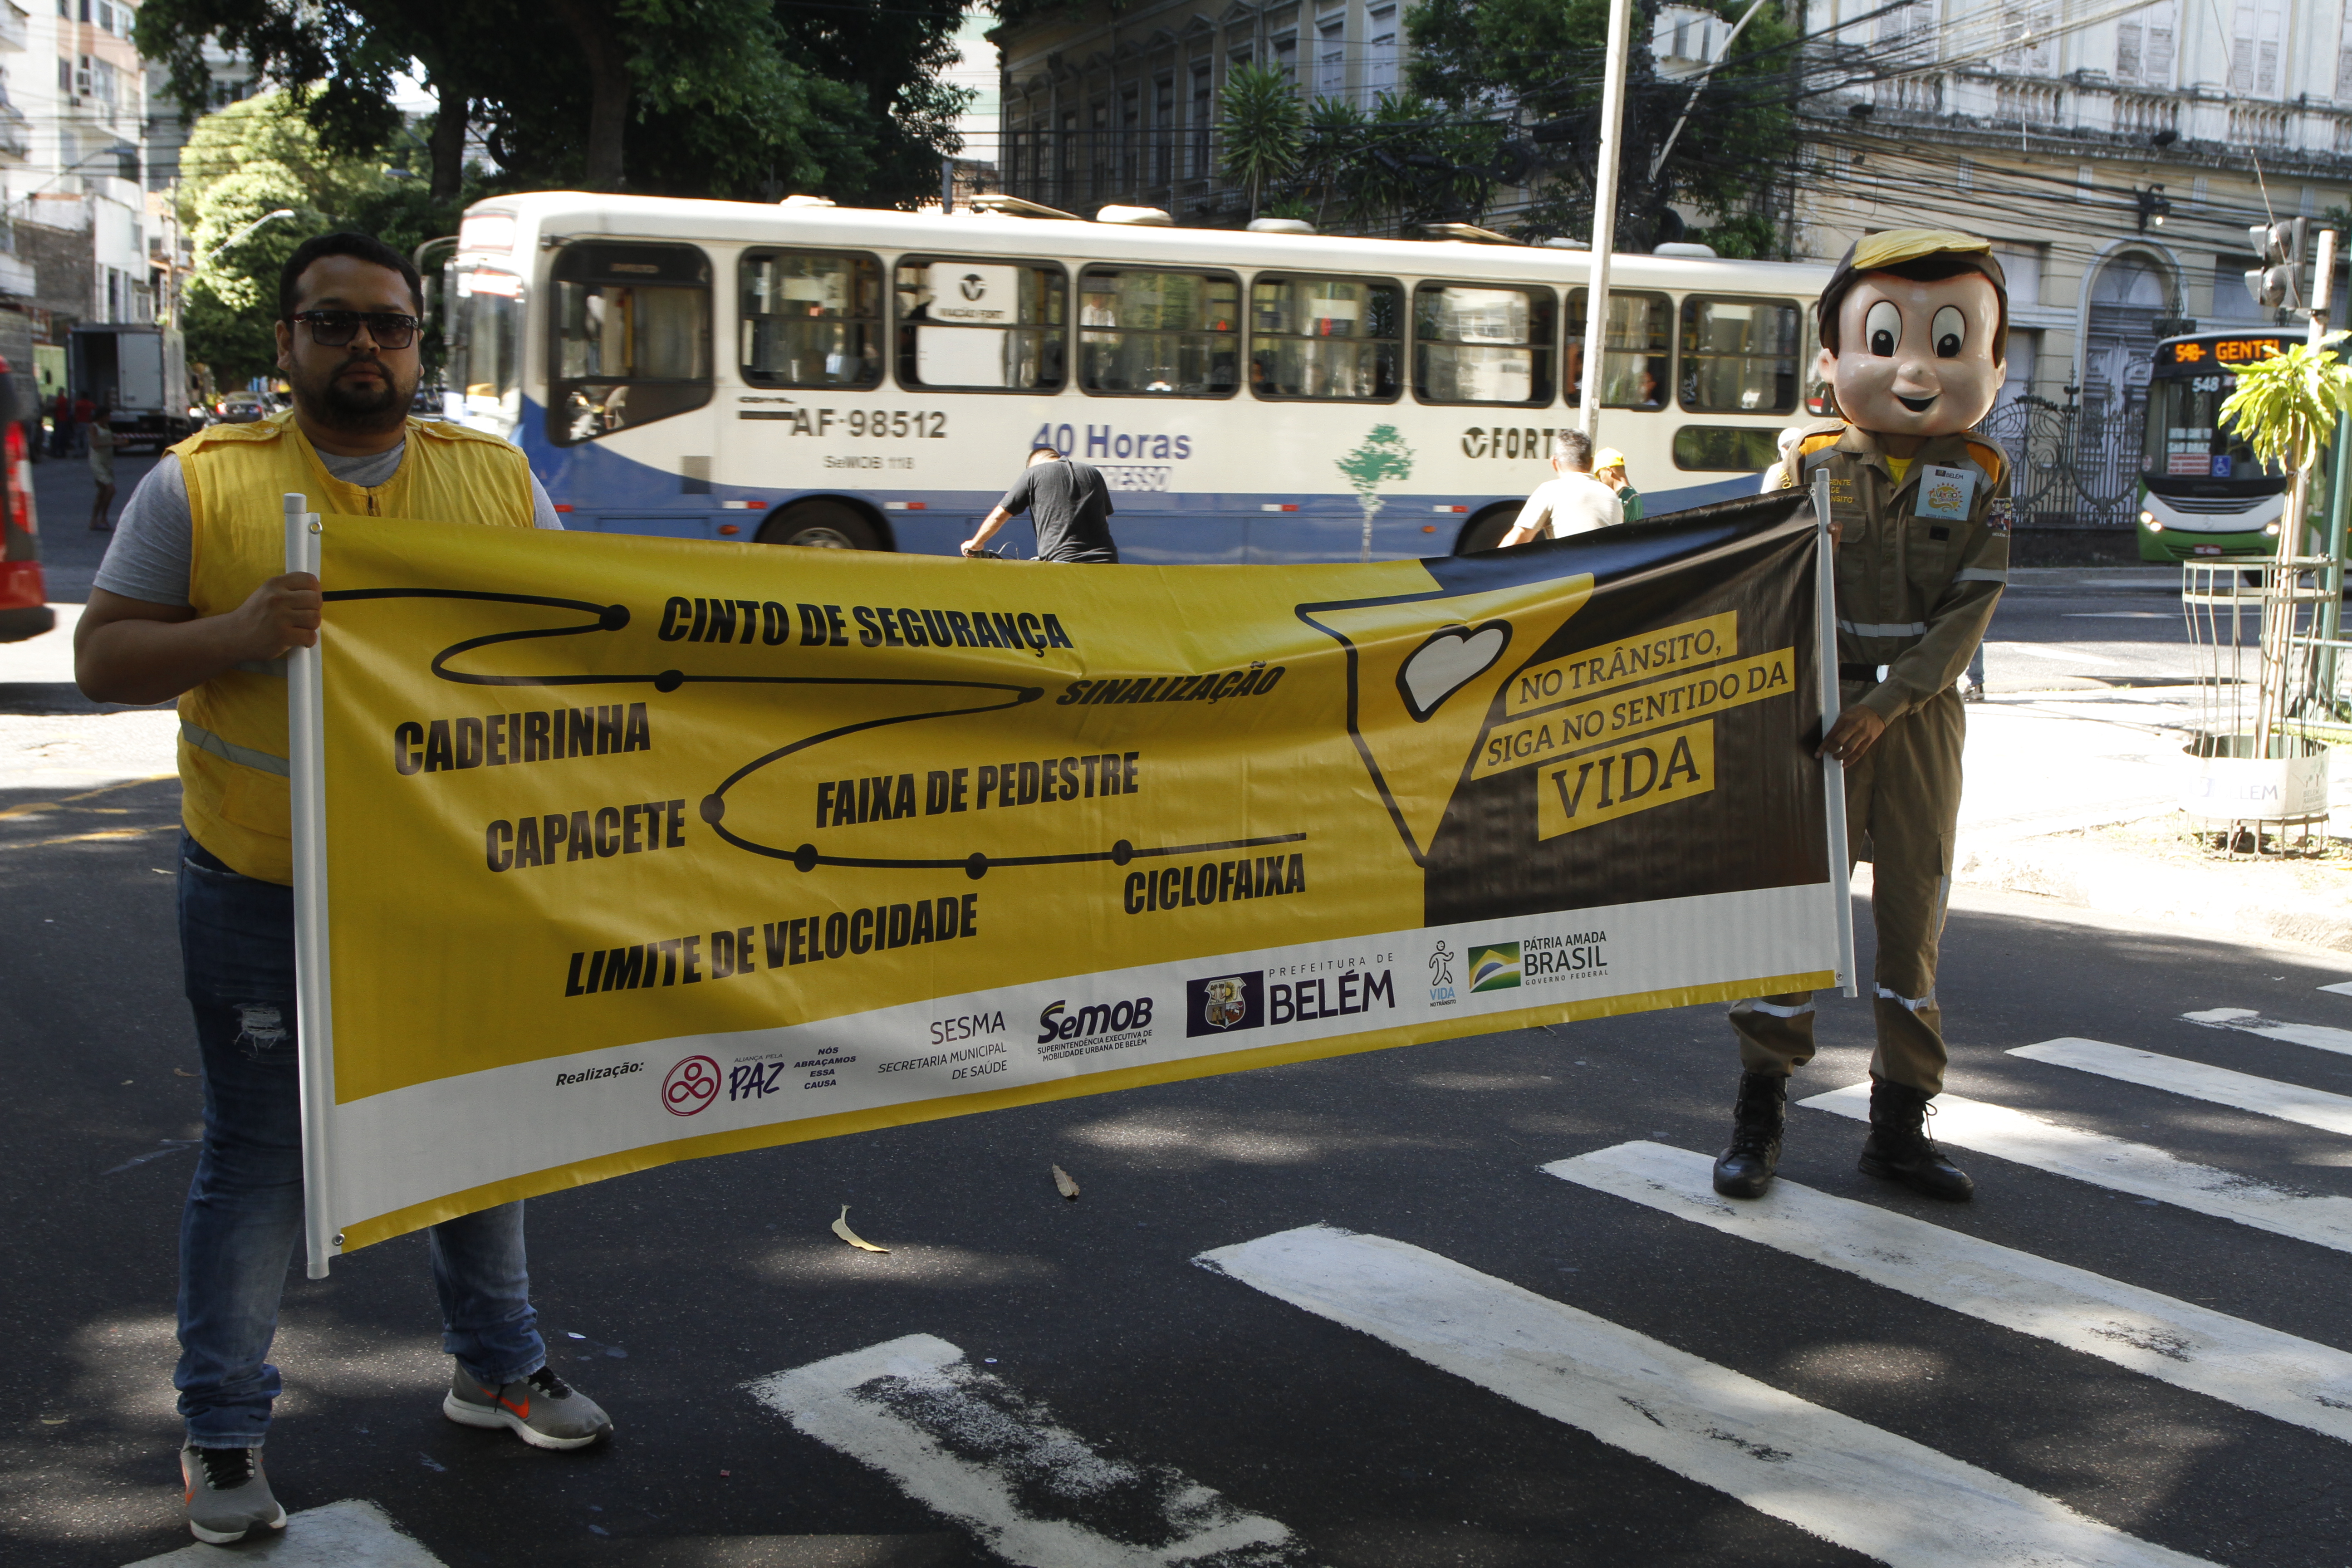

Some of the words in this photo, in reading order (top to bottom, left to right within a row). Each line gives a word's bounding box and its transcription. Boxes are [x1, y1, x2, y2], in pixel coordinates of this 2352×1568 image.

[2192, 376, 2220, 392] 548
[1032, 422, 1074, 456] 40
[1086, 424, 1192, 460] Horas
[1491, 427, 1573, 459] FORT
[1935, 490, 1958, 498] Verão
[658, 596, 790, 646] CINTO
[796, 603, 849, 647] DE
[852, 606, 1074, 658] SEGURANÇA
[1519, 669, 1563, 704] NO
[1569, 628, 1722, 690] TRÂNSITO,
[1056, 661, 1286, 706] SINALIZAÇÃO
[1487, 724, 1555, 767] SIGA
[1562, 710, 1605, 745] NO
[1612, 673, 1740, 730] SENTIDO
[1747, 661, 1788, 694] DA
[394, 702, 651, 776] CADEIRINHA
[817, 774, 916, 829] FAIXA
[925, 768, 969, 816] DE
[976, 751, 1140, 810] PEDESTRE
[1551, 735, 1701, 819] VIDA
[486, 799, 686, 873] CAPACETE
[1124, 853, 1306, 915] CICLOFAIXA
[564, 935, 701, 997] LIMITE
[711, 926, 755, 980] DE
[763, 893, 978, 969] VELOCIDADE
[1524, 936, 1563, 952] PÁTRIA
[1565, 931, 1607, 946] AMADA
[1269, 956, 1366, 978] PREFEITURA
[1377, 953, 1393, 963] DE
[1524, 945, 1607, 976] BRASIL
[1430, 986, 1455, 1000] VIDA
[1526, 975, 1565, 986] GOVERNO
[1571, 970, 1608, 980] FEDERAL
[1270, 969, 1396, 1025] BELÉM
[930, 1011, 1006, 1045] SESMA
[1037, 1037, 1104, 1054] SUPERINTENDÊNCIA
[1105, 1031, 1142, 1043] EXECUTIVA
[794, 1056, 857, 1068] ABRAÇAMOS
[818, 1046, 839, 1055] NÓS
[877, 1054, 948, 1073] SECRETARIA
[951, 1042, 1007, 1063] MUNICIPAL
[1043, 1049, 1084, 1062] MOBILIDADE
[1085, 1044, 1114, 1054] URBANA
[1125, 1037, 1147, 1047] BELÉM
[556, 1062, 644, 1086] Realização:
[729, 1062, 785, 1101] PAZ
[804, 1079, 837, 1089] CAUSA
[809, 1068, 835, 1078] ESSA
[952, 1068, 968, 1080] DE
[970, 1060, 1008, 1077] SAÚDE
